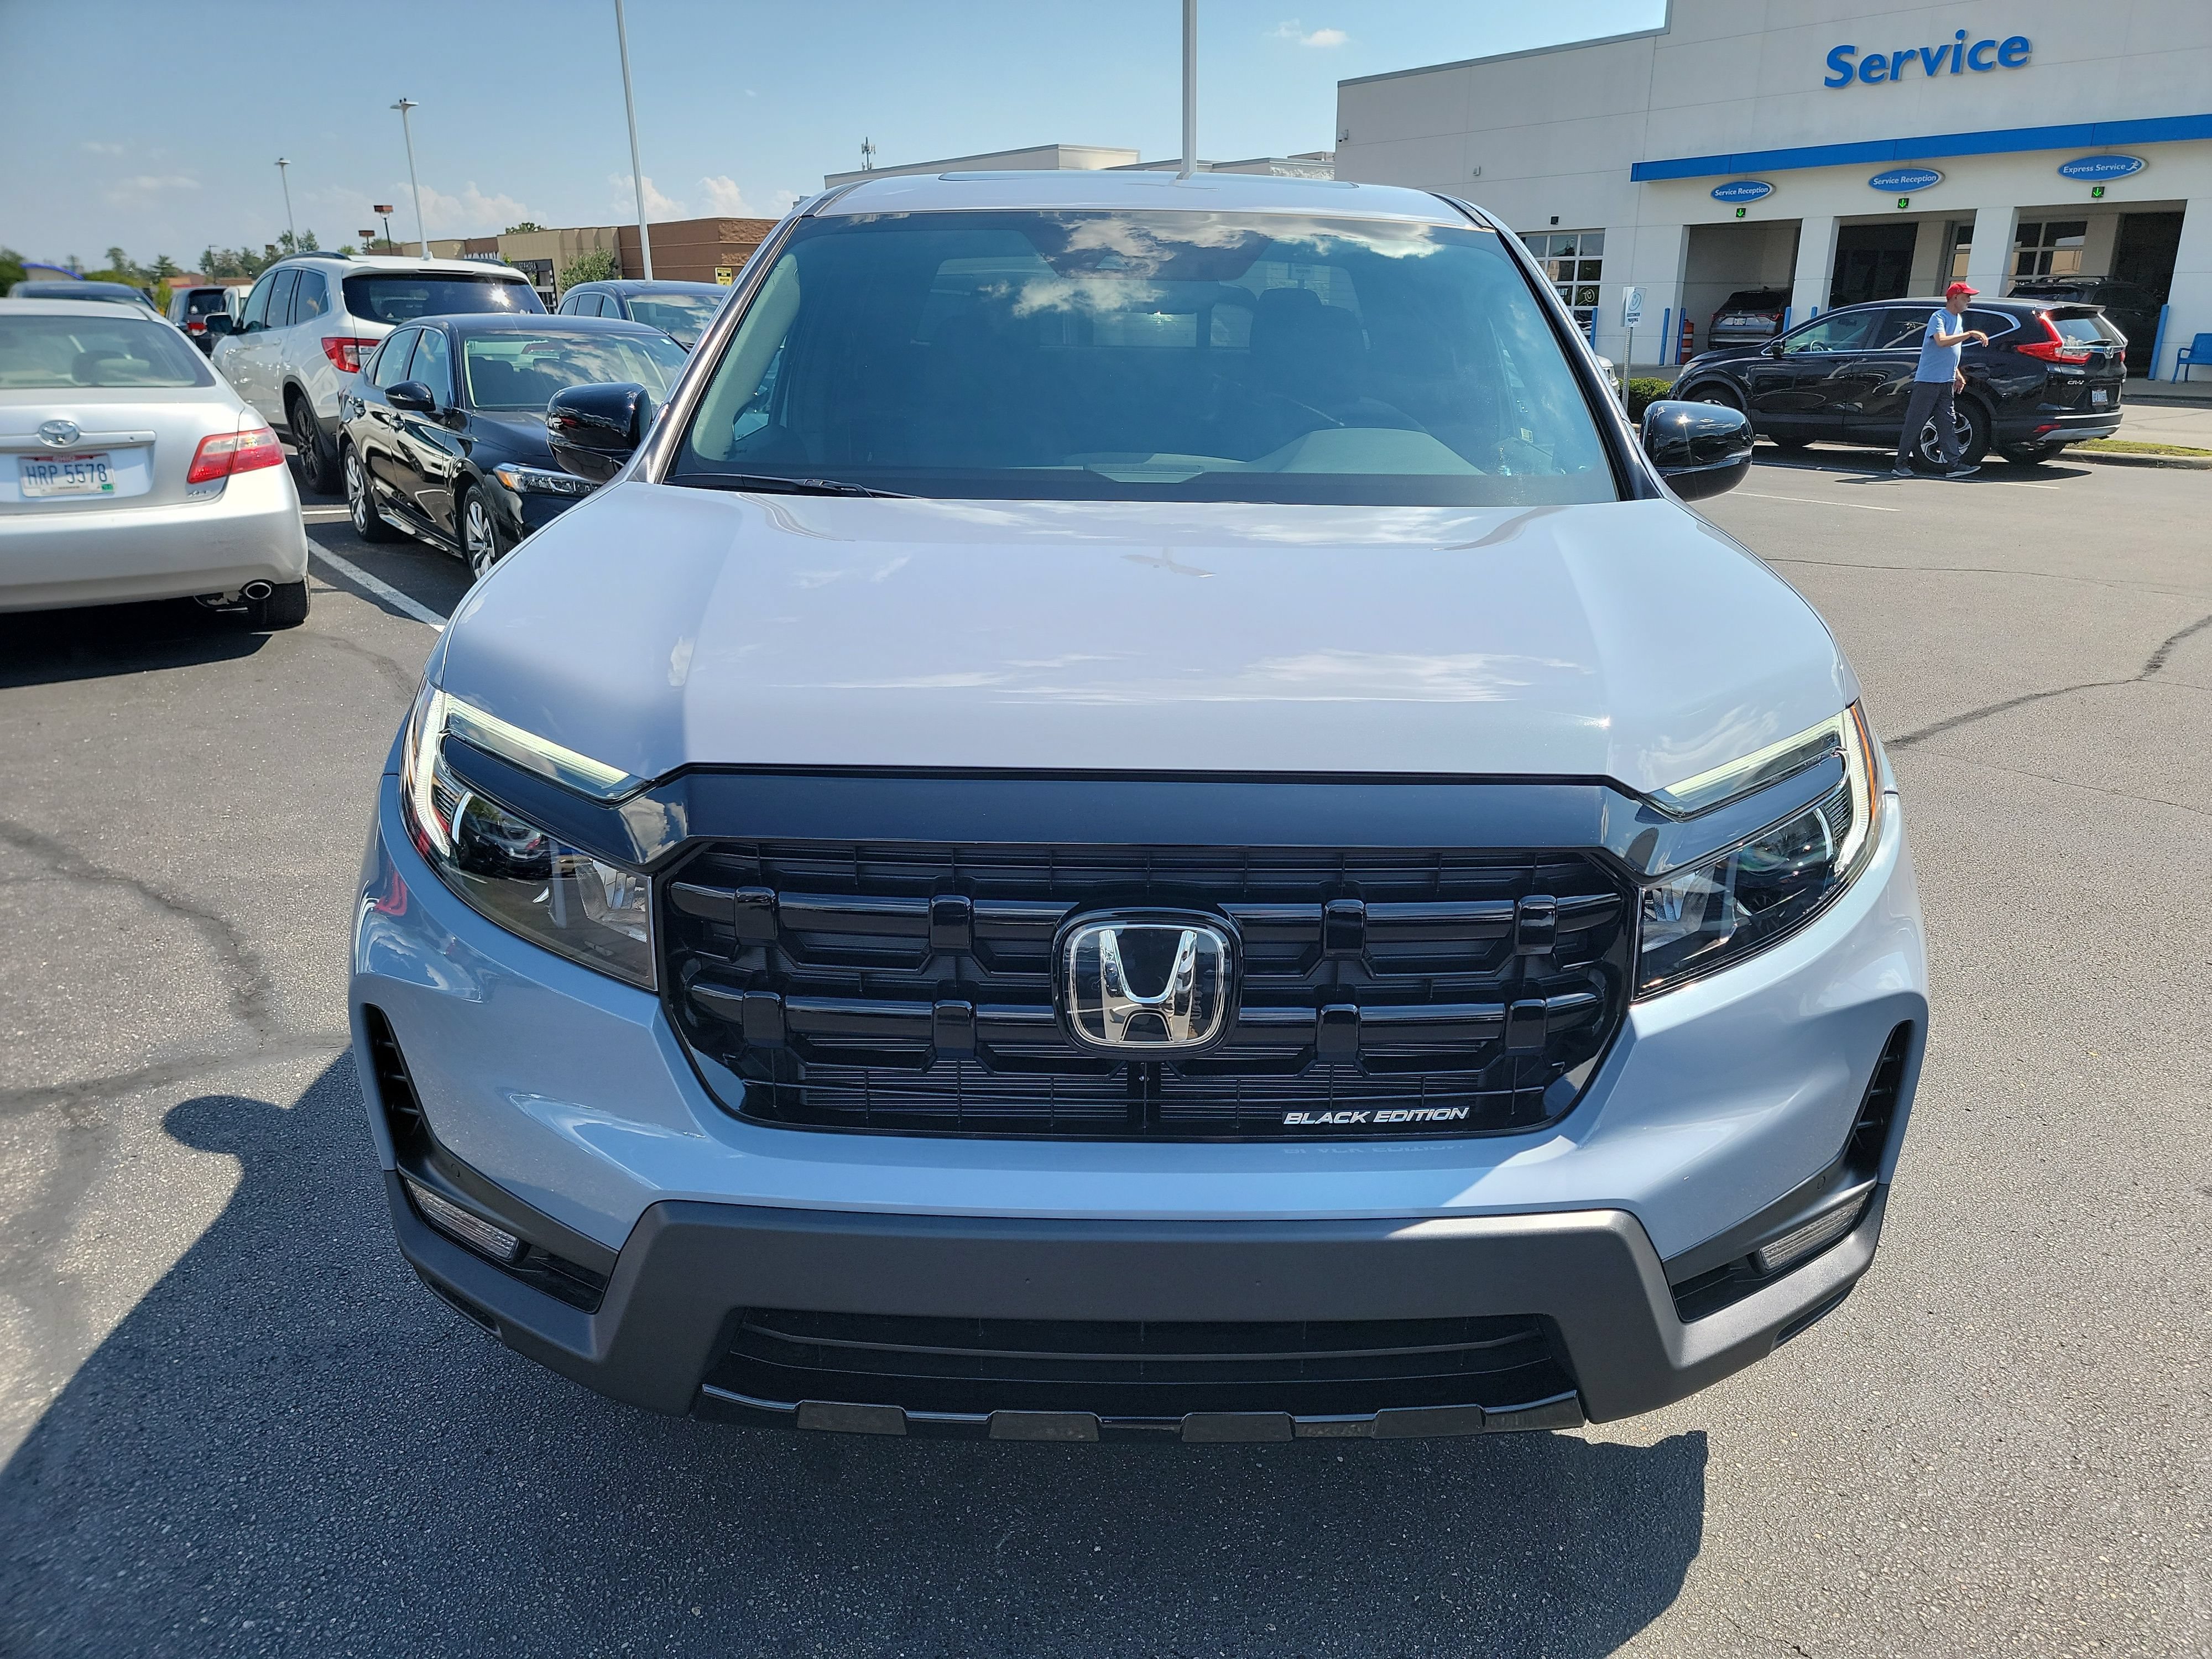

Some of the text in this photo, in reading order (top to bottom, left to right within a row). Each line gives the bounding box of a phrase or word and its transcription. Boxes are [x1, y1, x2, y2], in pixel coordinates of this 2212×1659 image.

[1823, 28, 2032, 88] Service
[2063, 166, 2094, 174] Express
[1901, 175, 1936, 184] Reception
[1738, 187, 1768, 195] Reception
[26, 463, 107, 485] HRP 5578
[1284, 1107, 1469, 1125] BLACK EDITION
